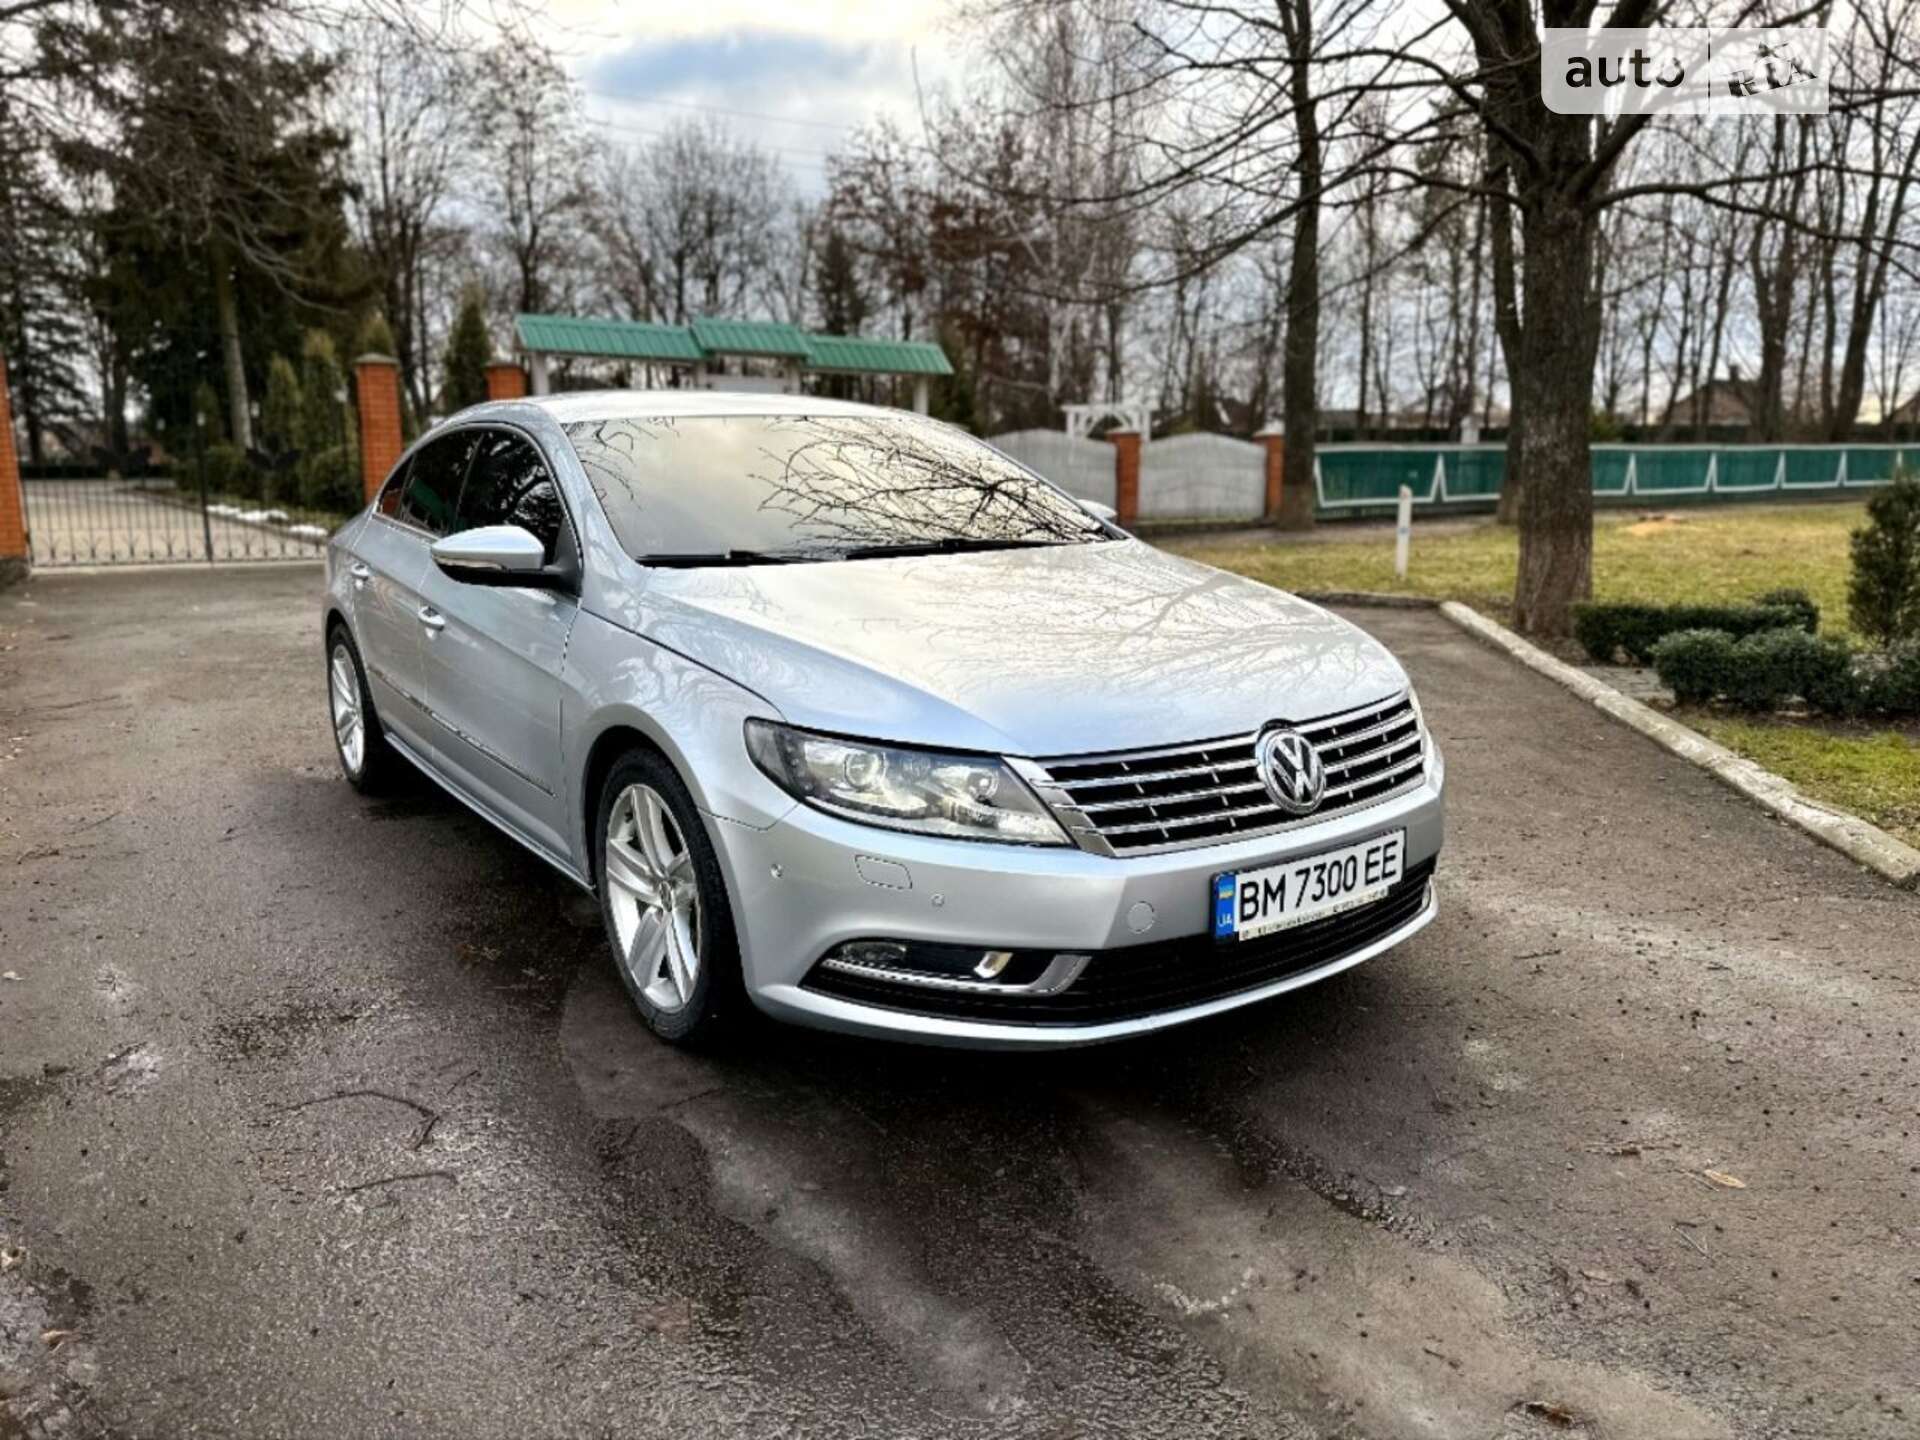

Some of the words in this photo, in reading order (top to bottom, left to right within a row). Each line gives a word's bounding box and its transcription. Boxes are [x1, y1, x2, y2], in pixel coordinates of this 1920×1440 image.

[1240, 873, 1286, 922] BM
[1295, 855, 1358, 908] 7300
[1365, 840, 1398, 886] EE
[1218, 914, 1233, 927] UA
